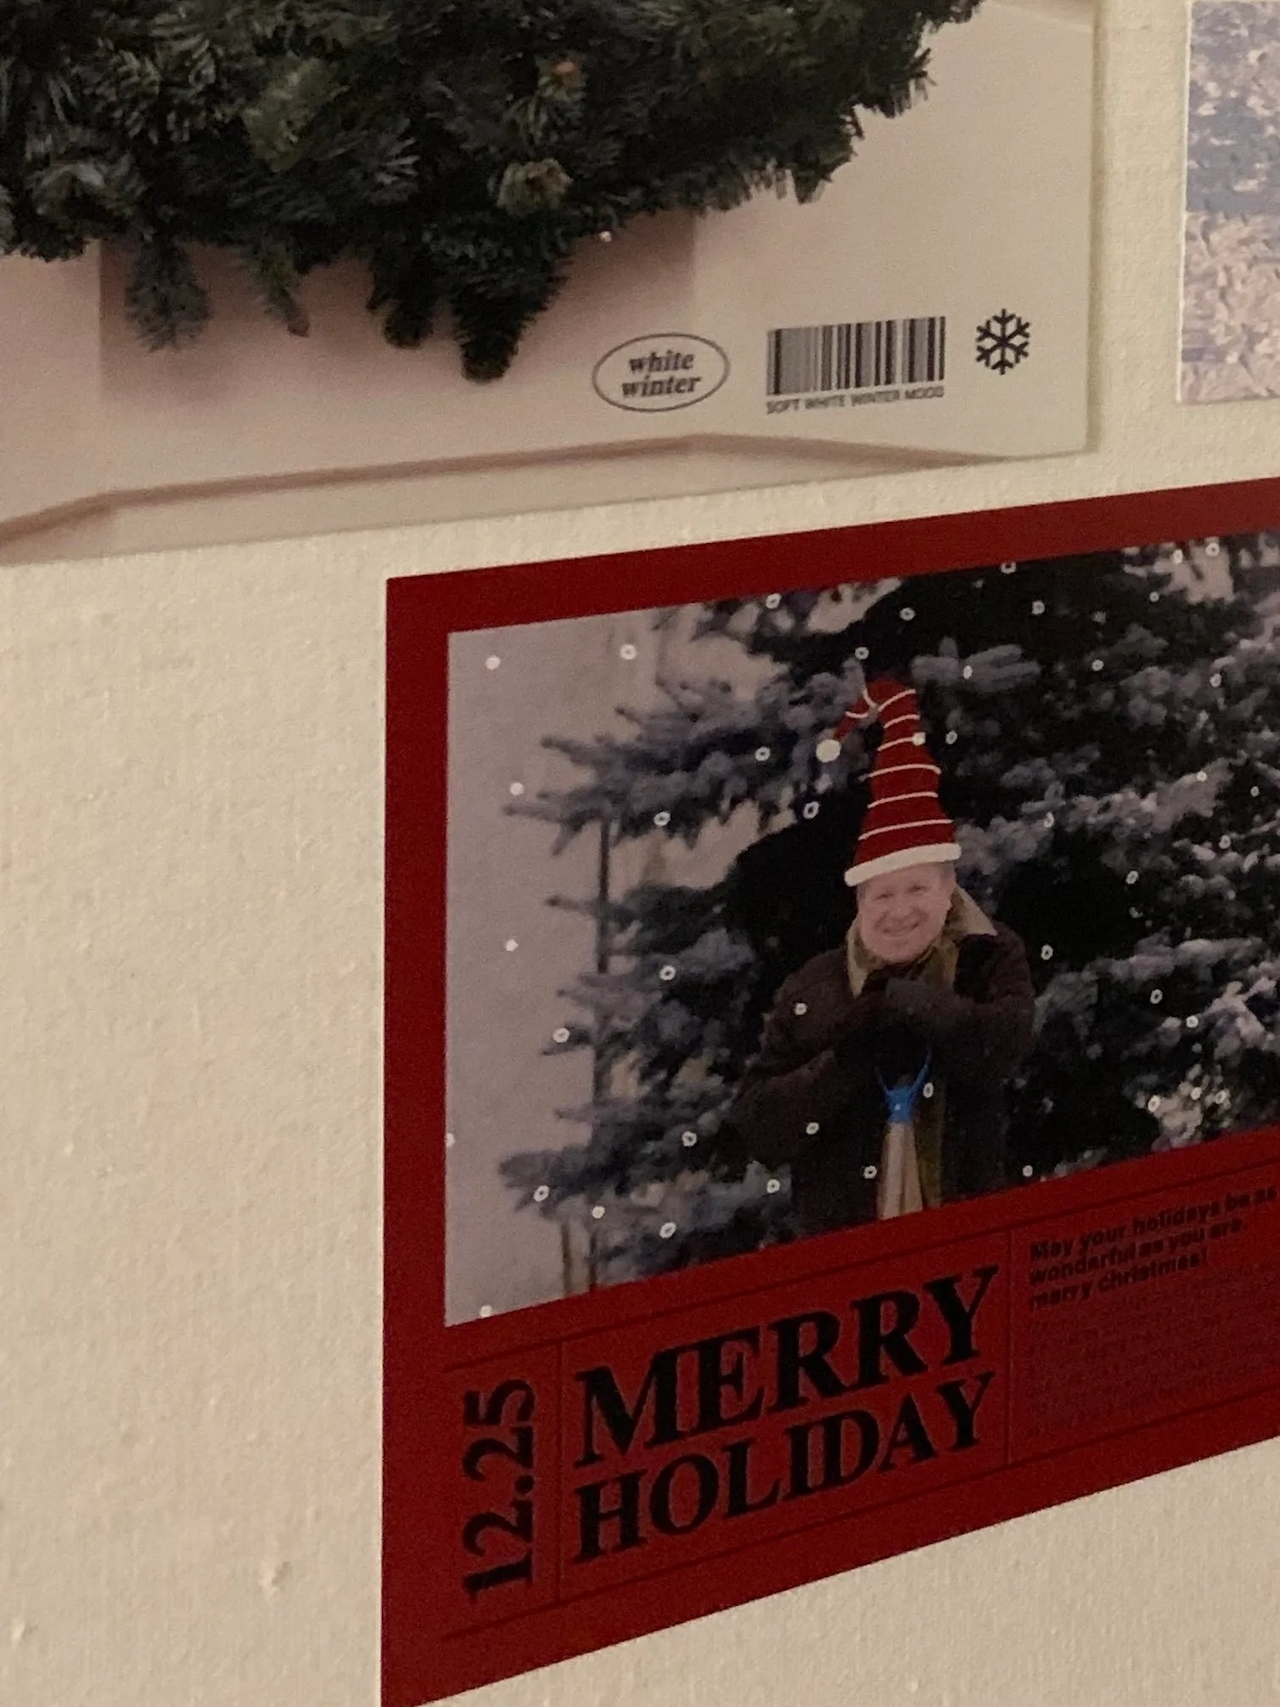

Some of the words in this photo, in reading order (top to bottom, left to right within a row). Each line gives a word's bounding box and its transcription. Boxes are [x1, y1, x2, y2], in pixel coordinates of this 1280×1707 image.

[621, 375, 702, 399] winter
[628, 350, 694, 375] white
[1029, 1240, 1136, 1285] wonderful
[1139, 1236, 1163, 1257] as
[1169, 1228, 1205, 1253] you
[1030, 1239, 1071, 1262] May
[1080, 1223, 1125, 1251] your
[1133, 1199, 1220, 1236] holidays
[1226, 1192, 1250, 1212] be
[1029, 1281, 1093, 1311] merry
[574, 1266, 999, 1469] MERRY
[462, 1379, 535, 1599] 12.25
[573, 1371, 995, 1564] HOLIDAY
